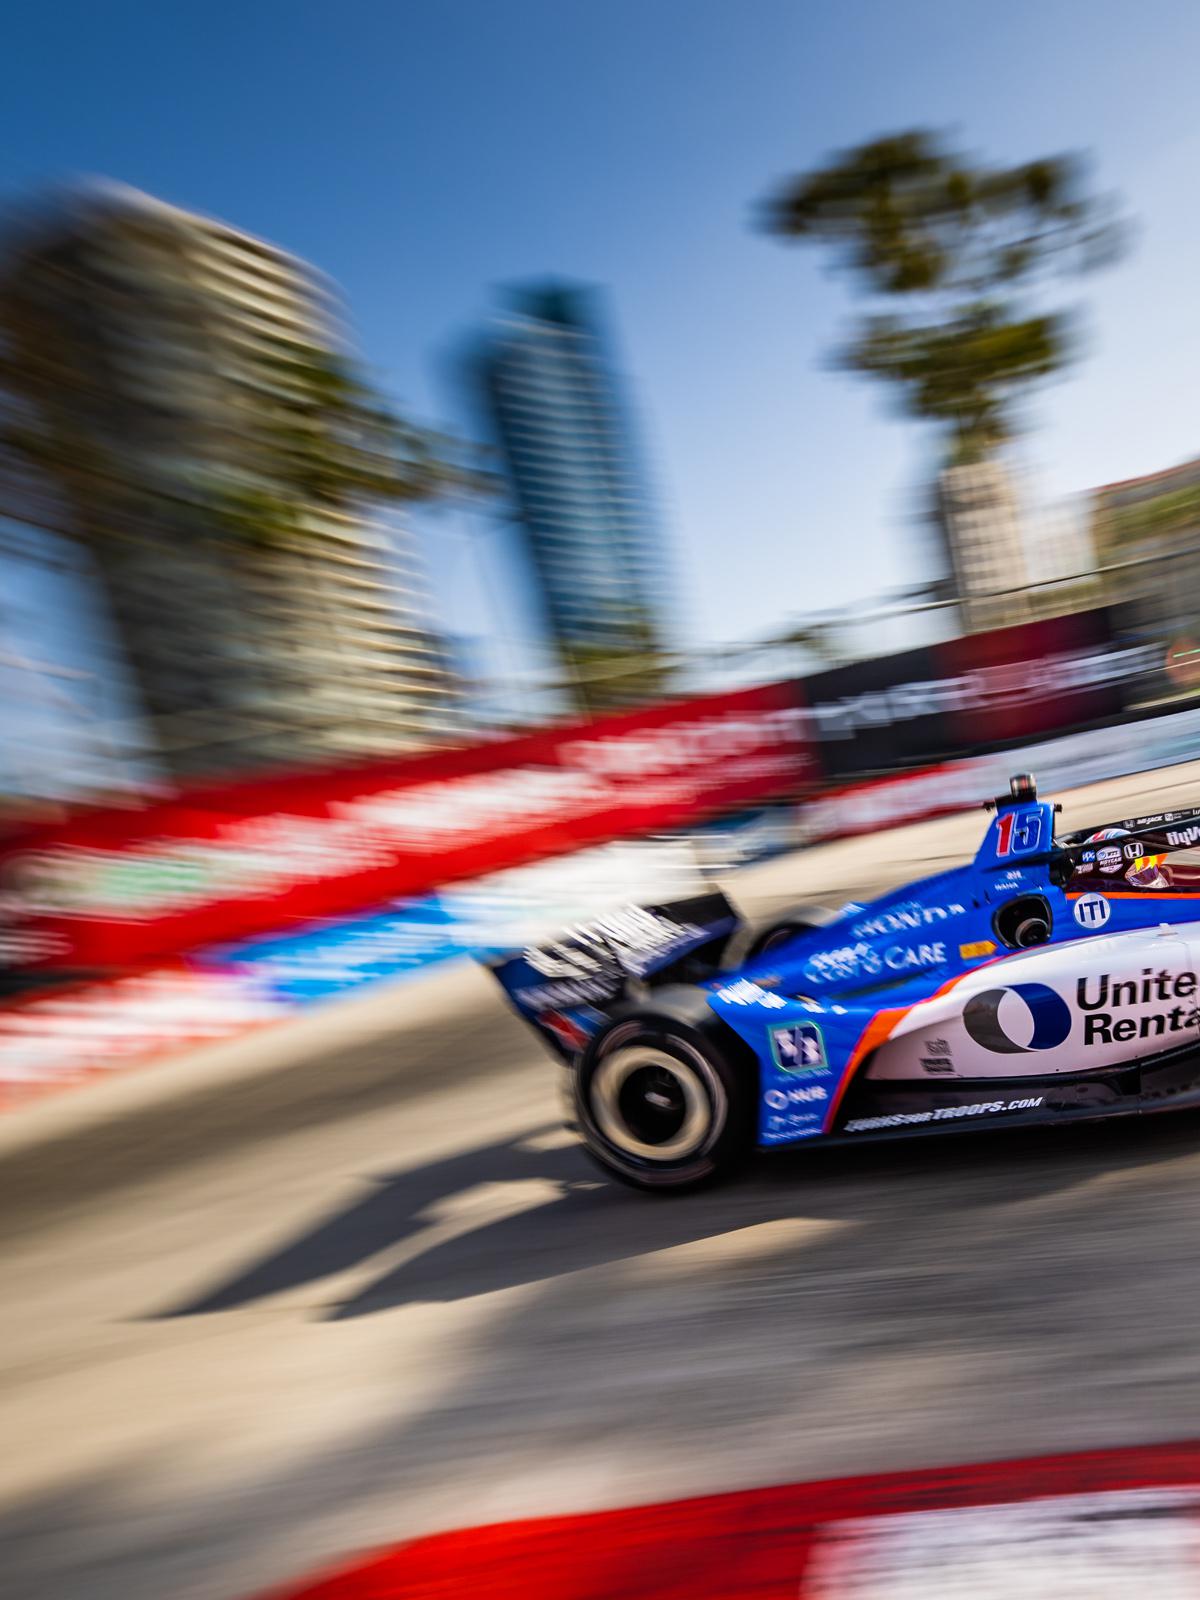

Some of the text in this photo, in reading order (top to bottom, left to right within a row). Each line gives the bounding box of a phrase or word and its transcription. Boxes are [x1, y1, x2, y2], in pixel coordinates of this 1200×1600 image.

[996, 807, 1043, 858] 15
[1079, 900, 1106, 922] ITI
[885, 942, 947, 969] CARE
